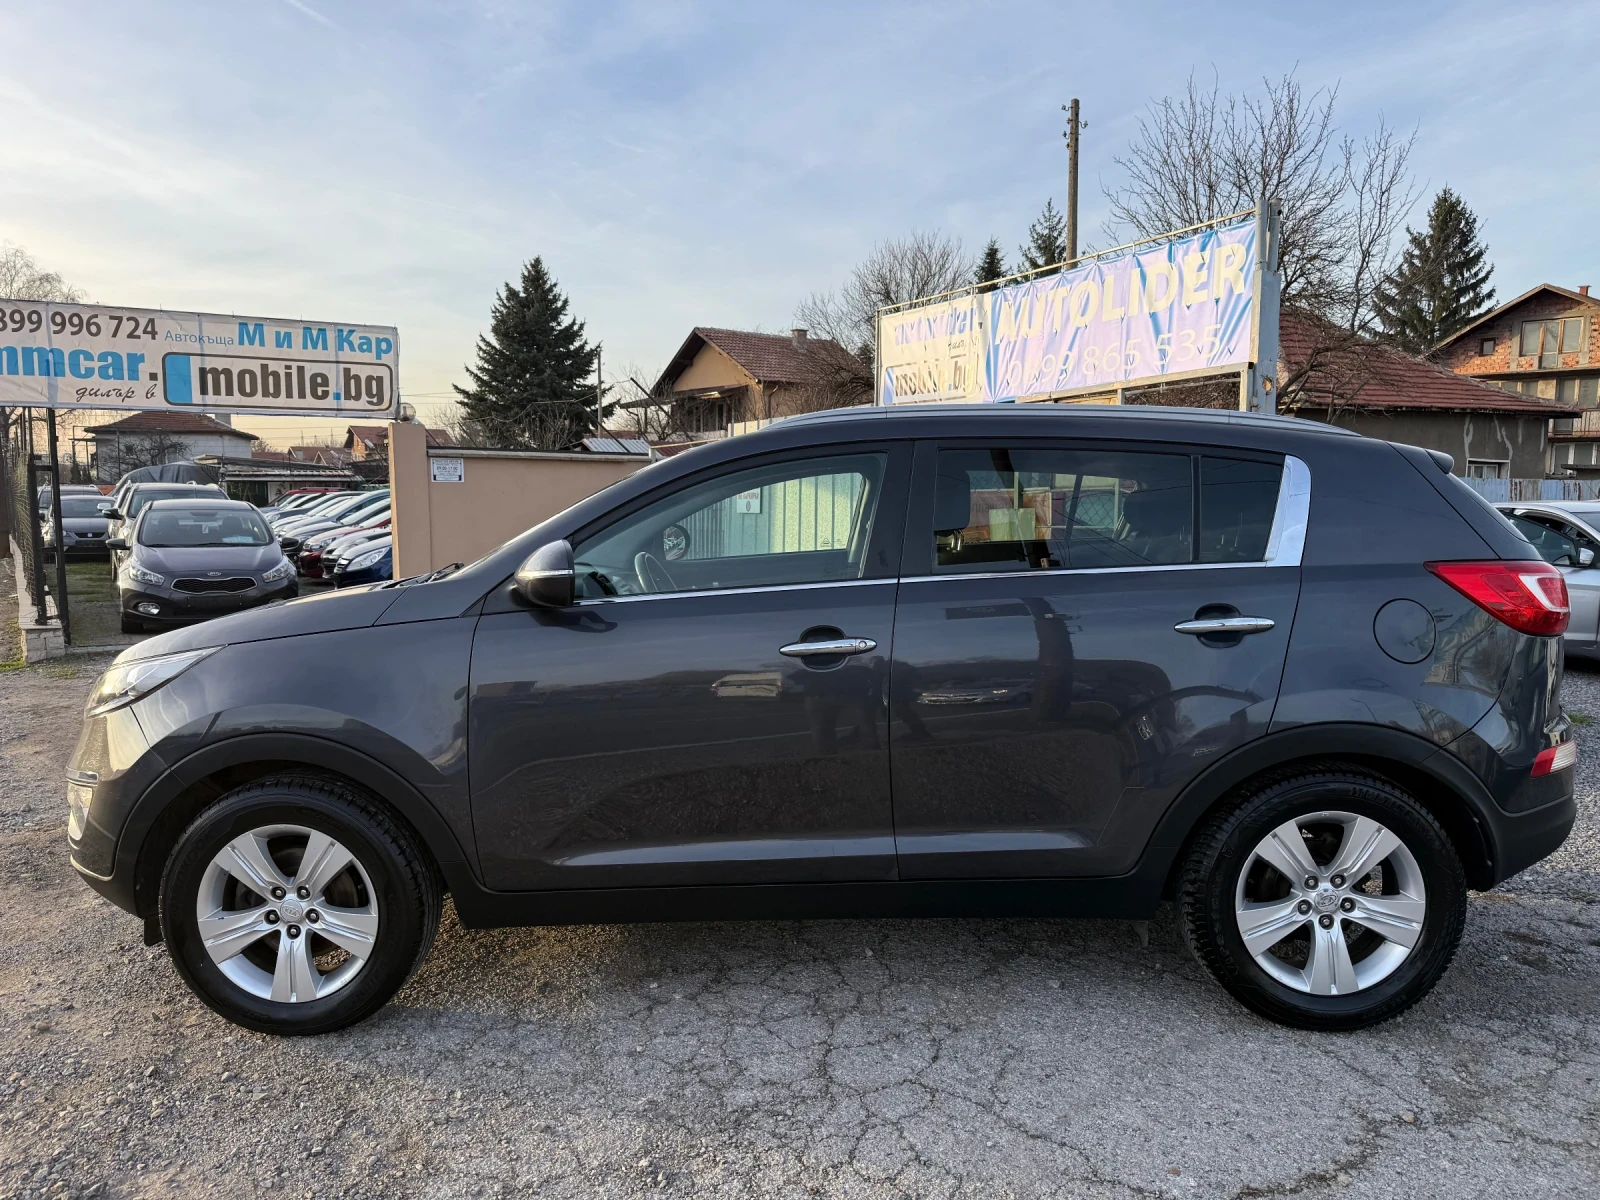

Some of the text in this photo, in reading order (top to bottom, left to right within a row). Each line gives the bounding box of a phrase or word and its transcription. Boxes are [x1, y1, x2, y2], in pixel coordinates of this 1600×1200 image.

[995, 242, 1247, 345] AUTOLIDER
[50, 311, 102, 337] 996
[108, 315, 158, 340] 724
[164, 321, 393, 361] Автокъща М и М Кар
[1082, 337, 1142, 375] 865
[1153, 324, 1222, 366] 535
[198, 363, 385, 406] mobile.bg
